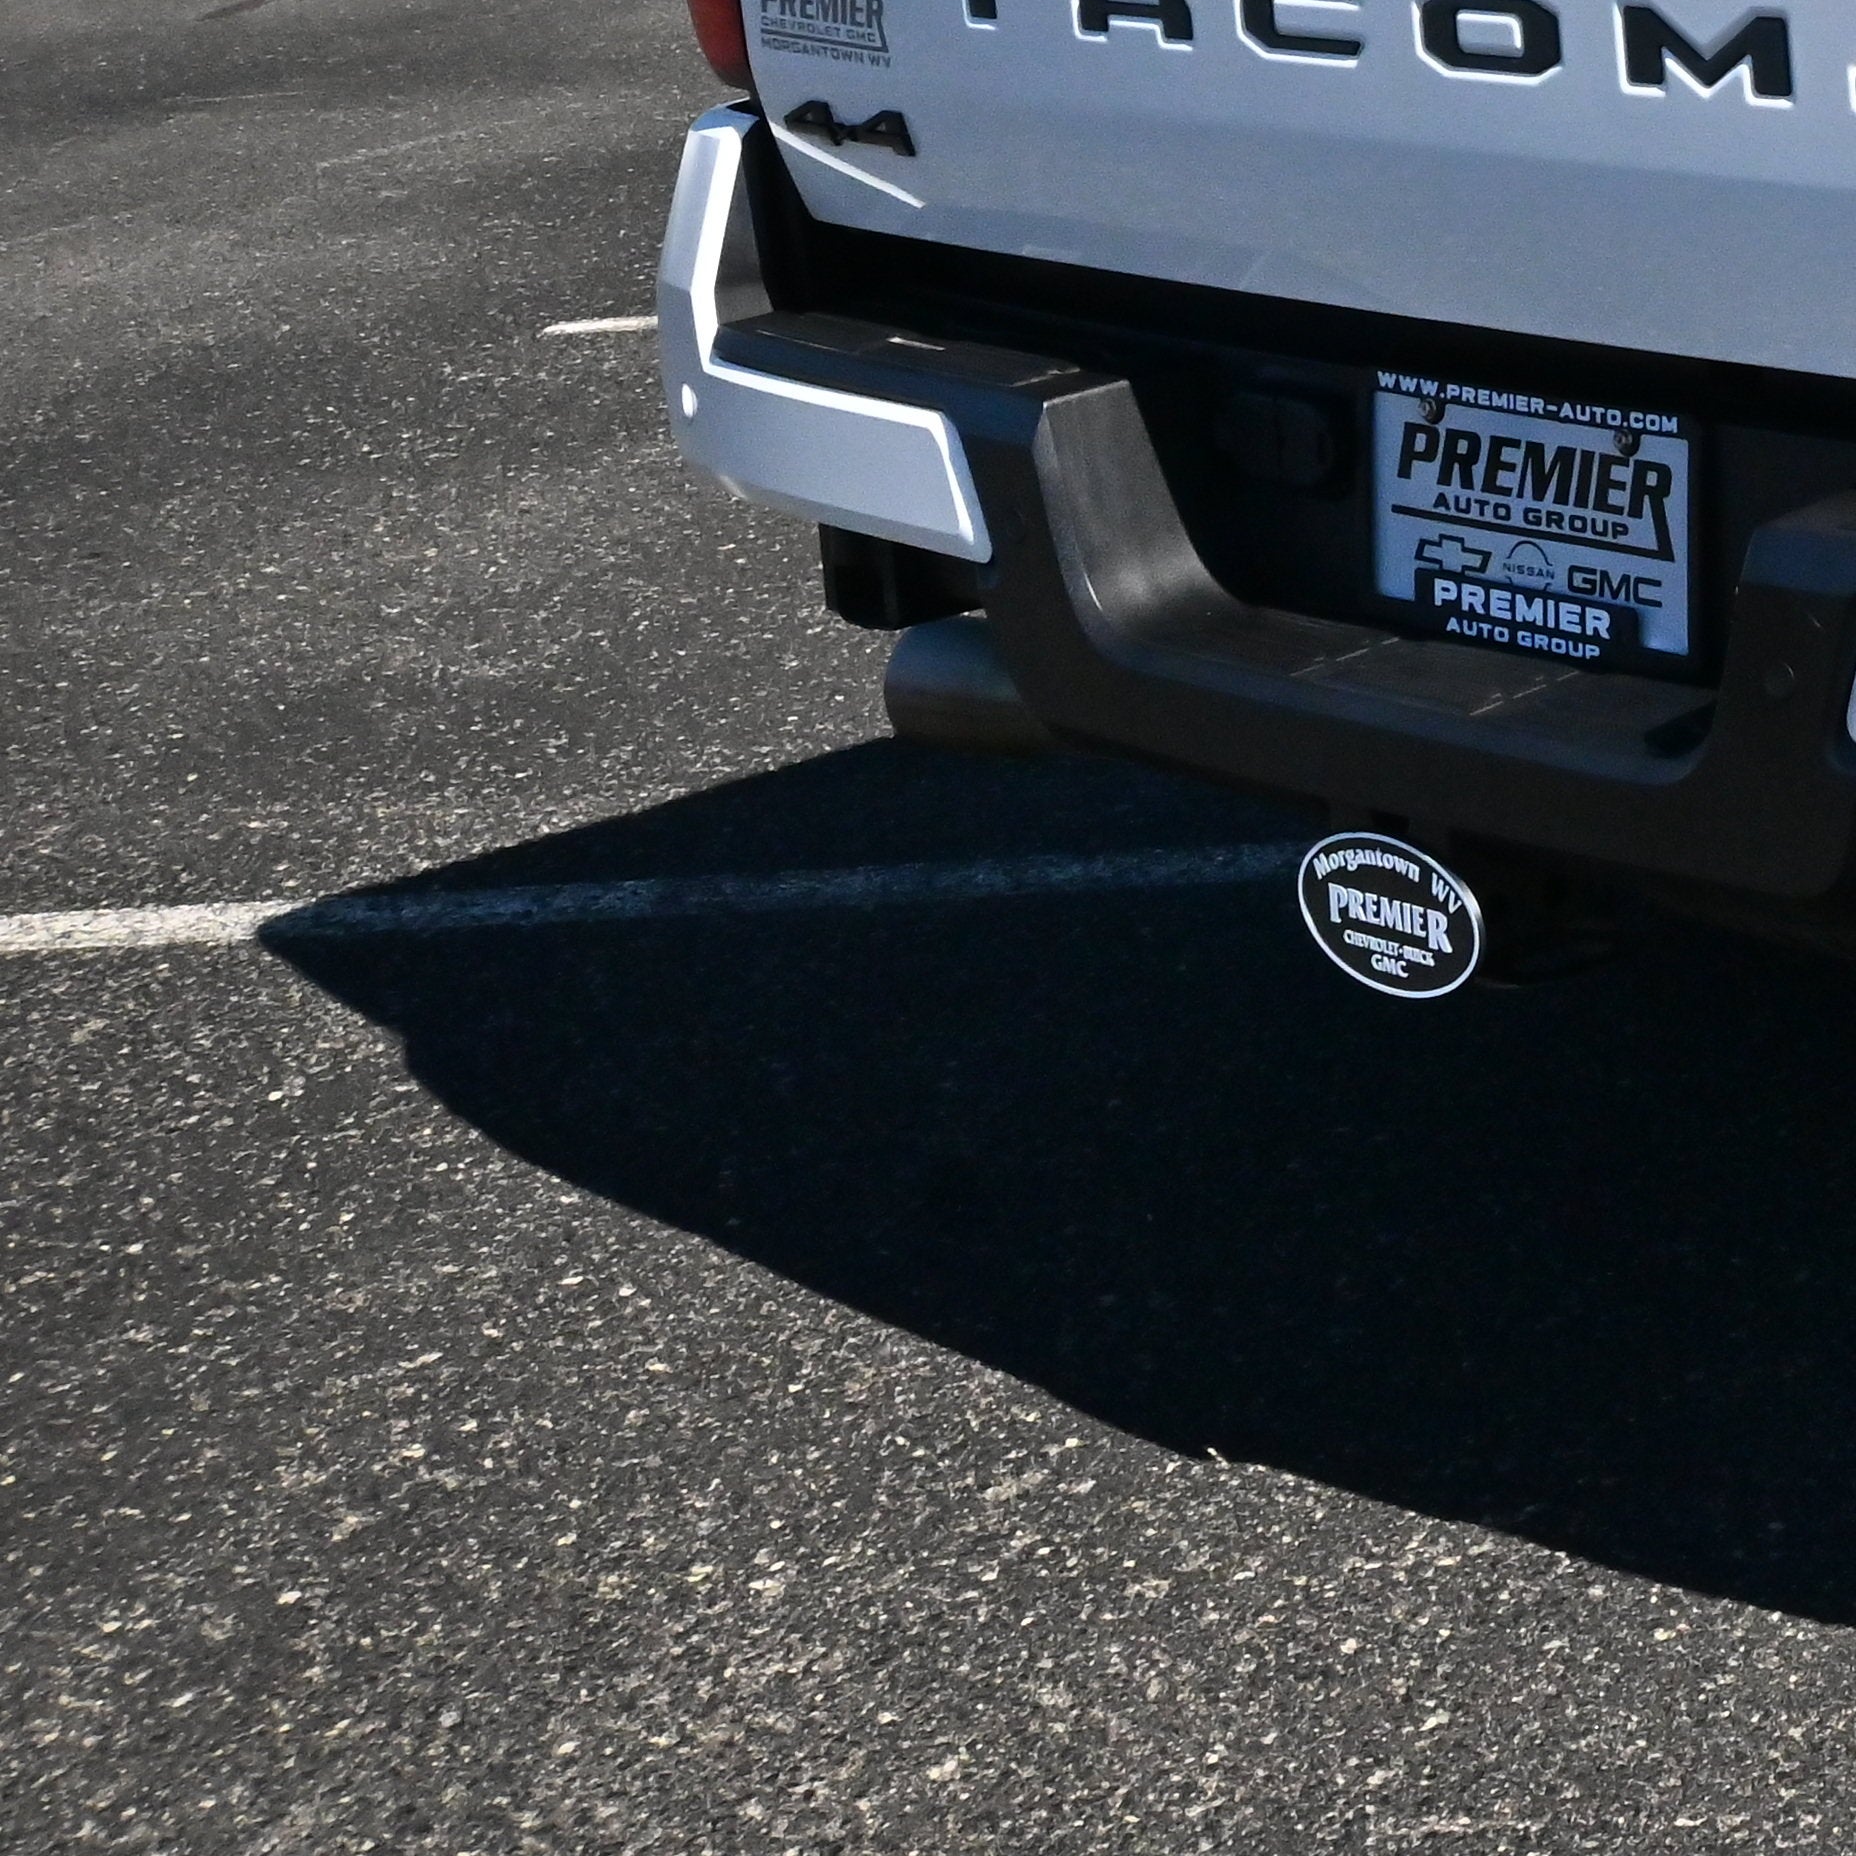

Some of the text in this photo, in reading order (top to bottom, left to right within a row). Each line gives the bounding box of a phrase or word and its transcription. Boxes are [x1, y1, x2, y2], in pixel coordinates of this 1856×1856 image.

[761, 15, 877, 43] CHEVROLET GMC
[761, 37, 891, 69] MORGANTOWN WV
[1377, 371, 1679, 435] WWW.PREMIER-AUTO.COM
[1397, 421, 1673, 528] PREMIER
[1432, 492, 1630, 540] AUTO GROUP
[1502, 561, 1556, 581] NISSAN
[1567, 565, 1663, 609] GMC
[1433, 577, 1612, 641] PREMIER
[1445, 615, 1601, 660] AUTO GROUP
[1312, 848, 1464, 914] Morgantown WV
[1327, 882, 1454, 954] PREMIER
[1370, 953, 1410, 979] GMC
